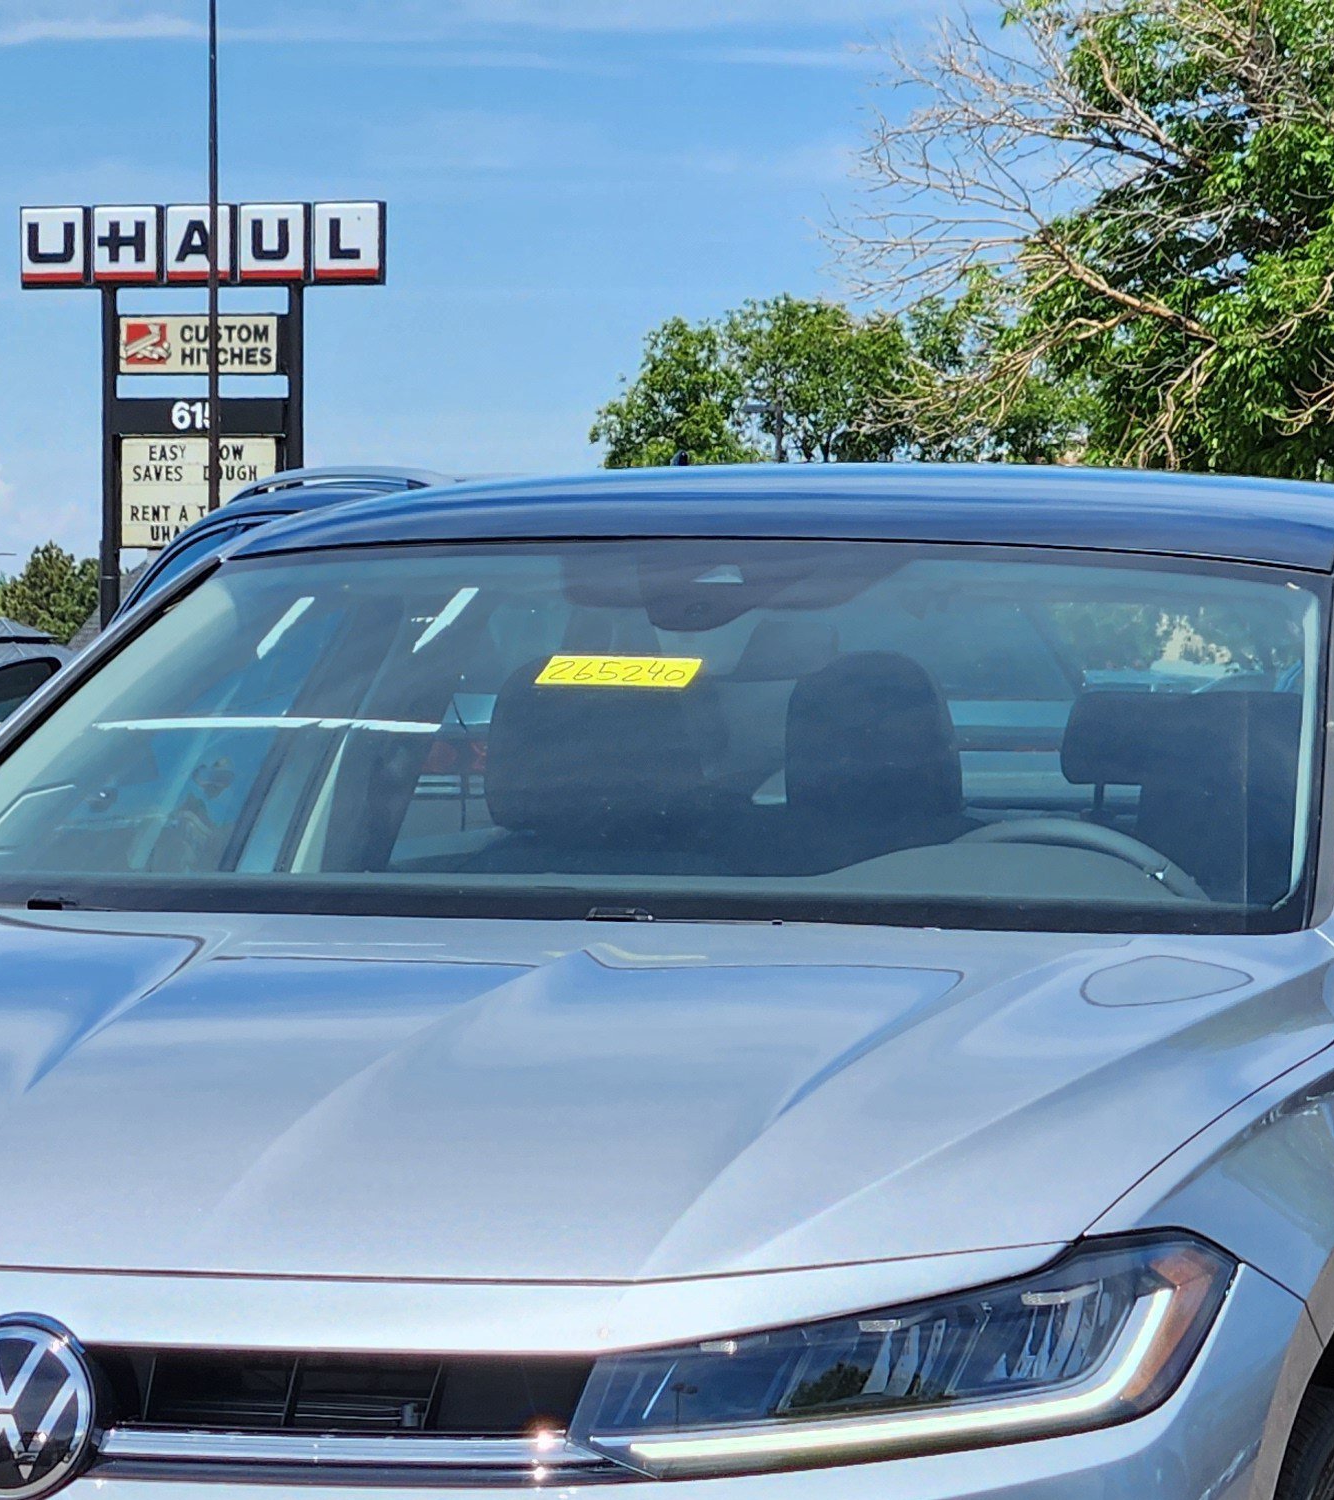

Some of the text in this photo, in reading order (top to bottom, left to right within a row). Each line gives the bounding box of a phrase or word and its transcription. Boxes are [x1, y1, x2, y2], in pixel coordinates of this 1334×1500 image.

[149, 445, 244, 461] EASY OW
[133, 465, 183, 481] SAVES
[130, 505, 171, 521] RENT
[179, 506, 189, 521] A
[548, 660, 686, 682] 265240
